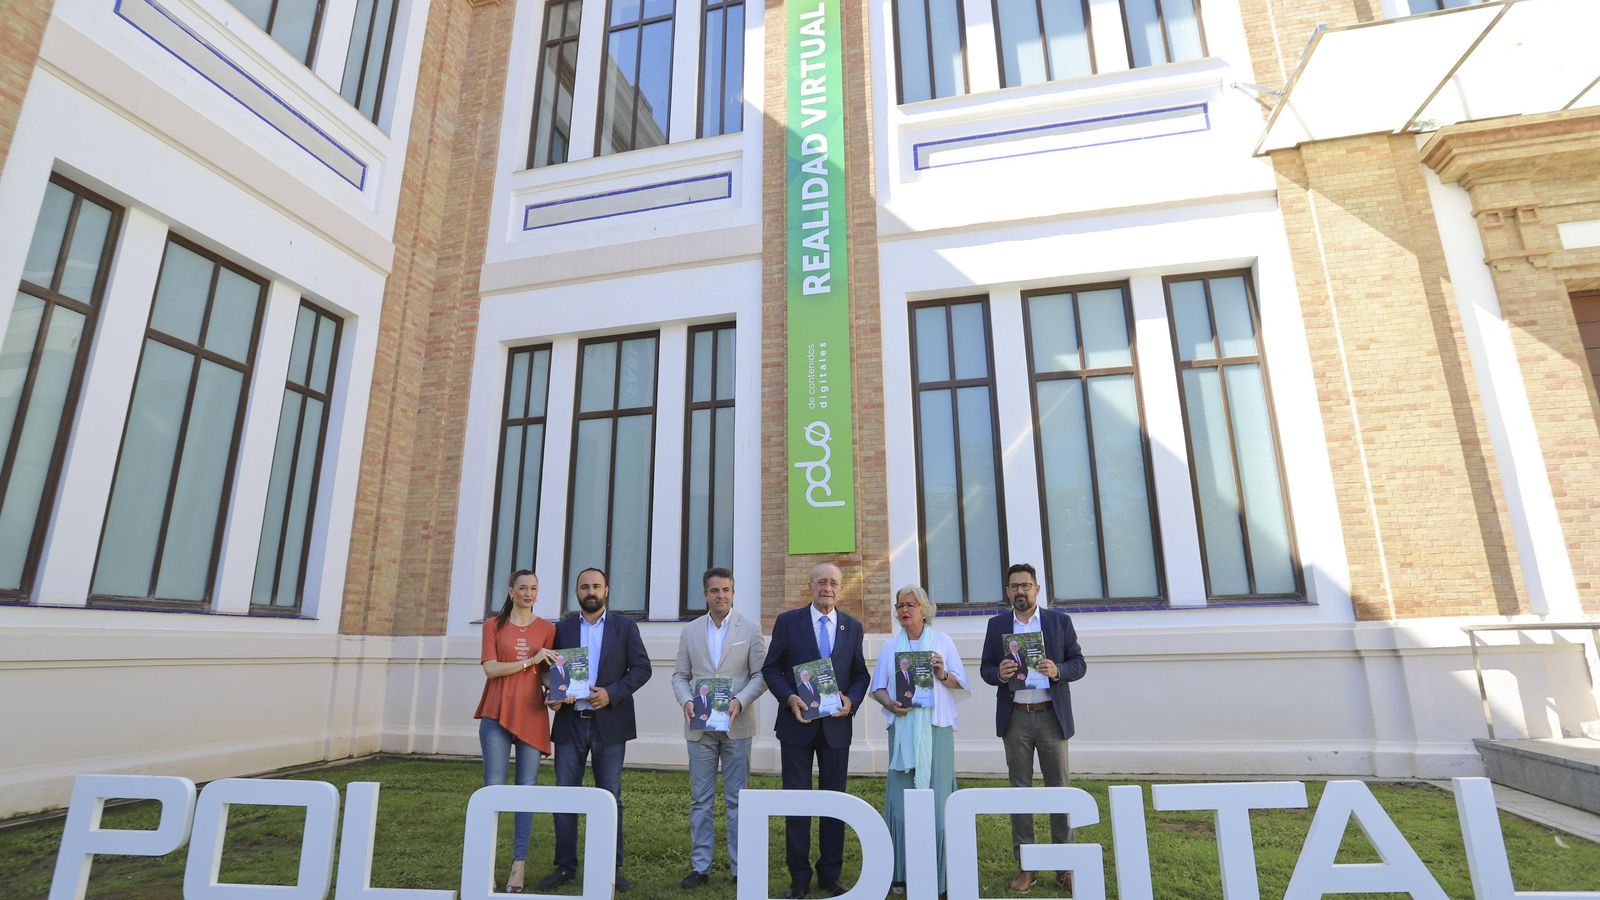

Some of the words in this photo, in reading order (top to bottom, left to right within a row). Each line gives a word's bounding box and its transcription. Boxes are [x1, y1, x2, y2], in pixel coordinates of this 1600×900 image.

[800, 1, 827, 129] VIRTUAL
[802, 133, 831, 296] REALIDAD
[807, 344, 816, 395] contenidos
[808, 396, 816, 410] de
[819, 341, 829, 409] digitales
[48, 774, 618, 900] POLO
[736, 777, 1600, 900] DIGITAL
